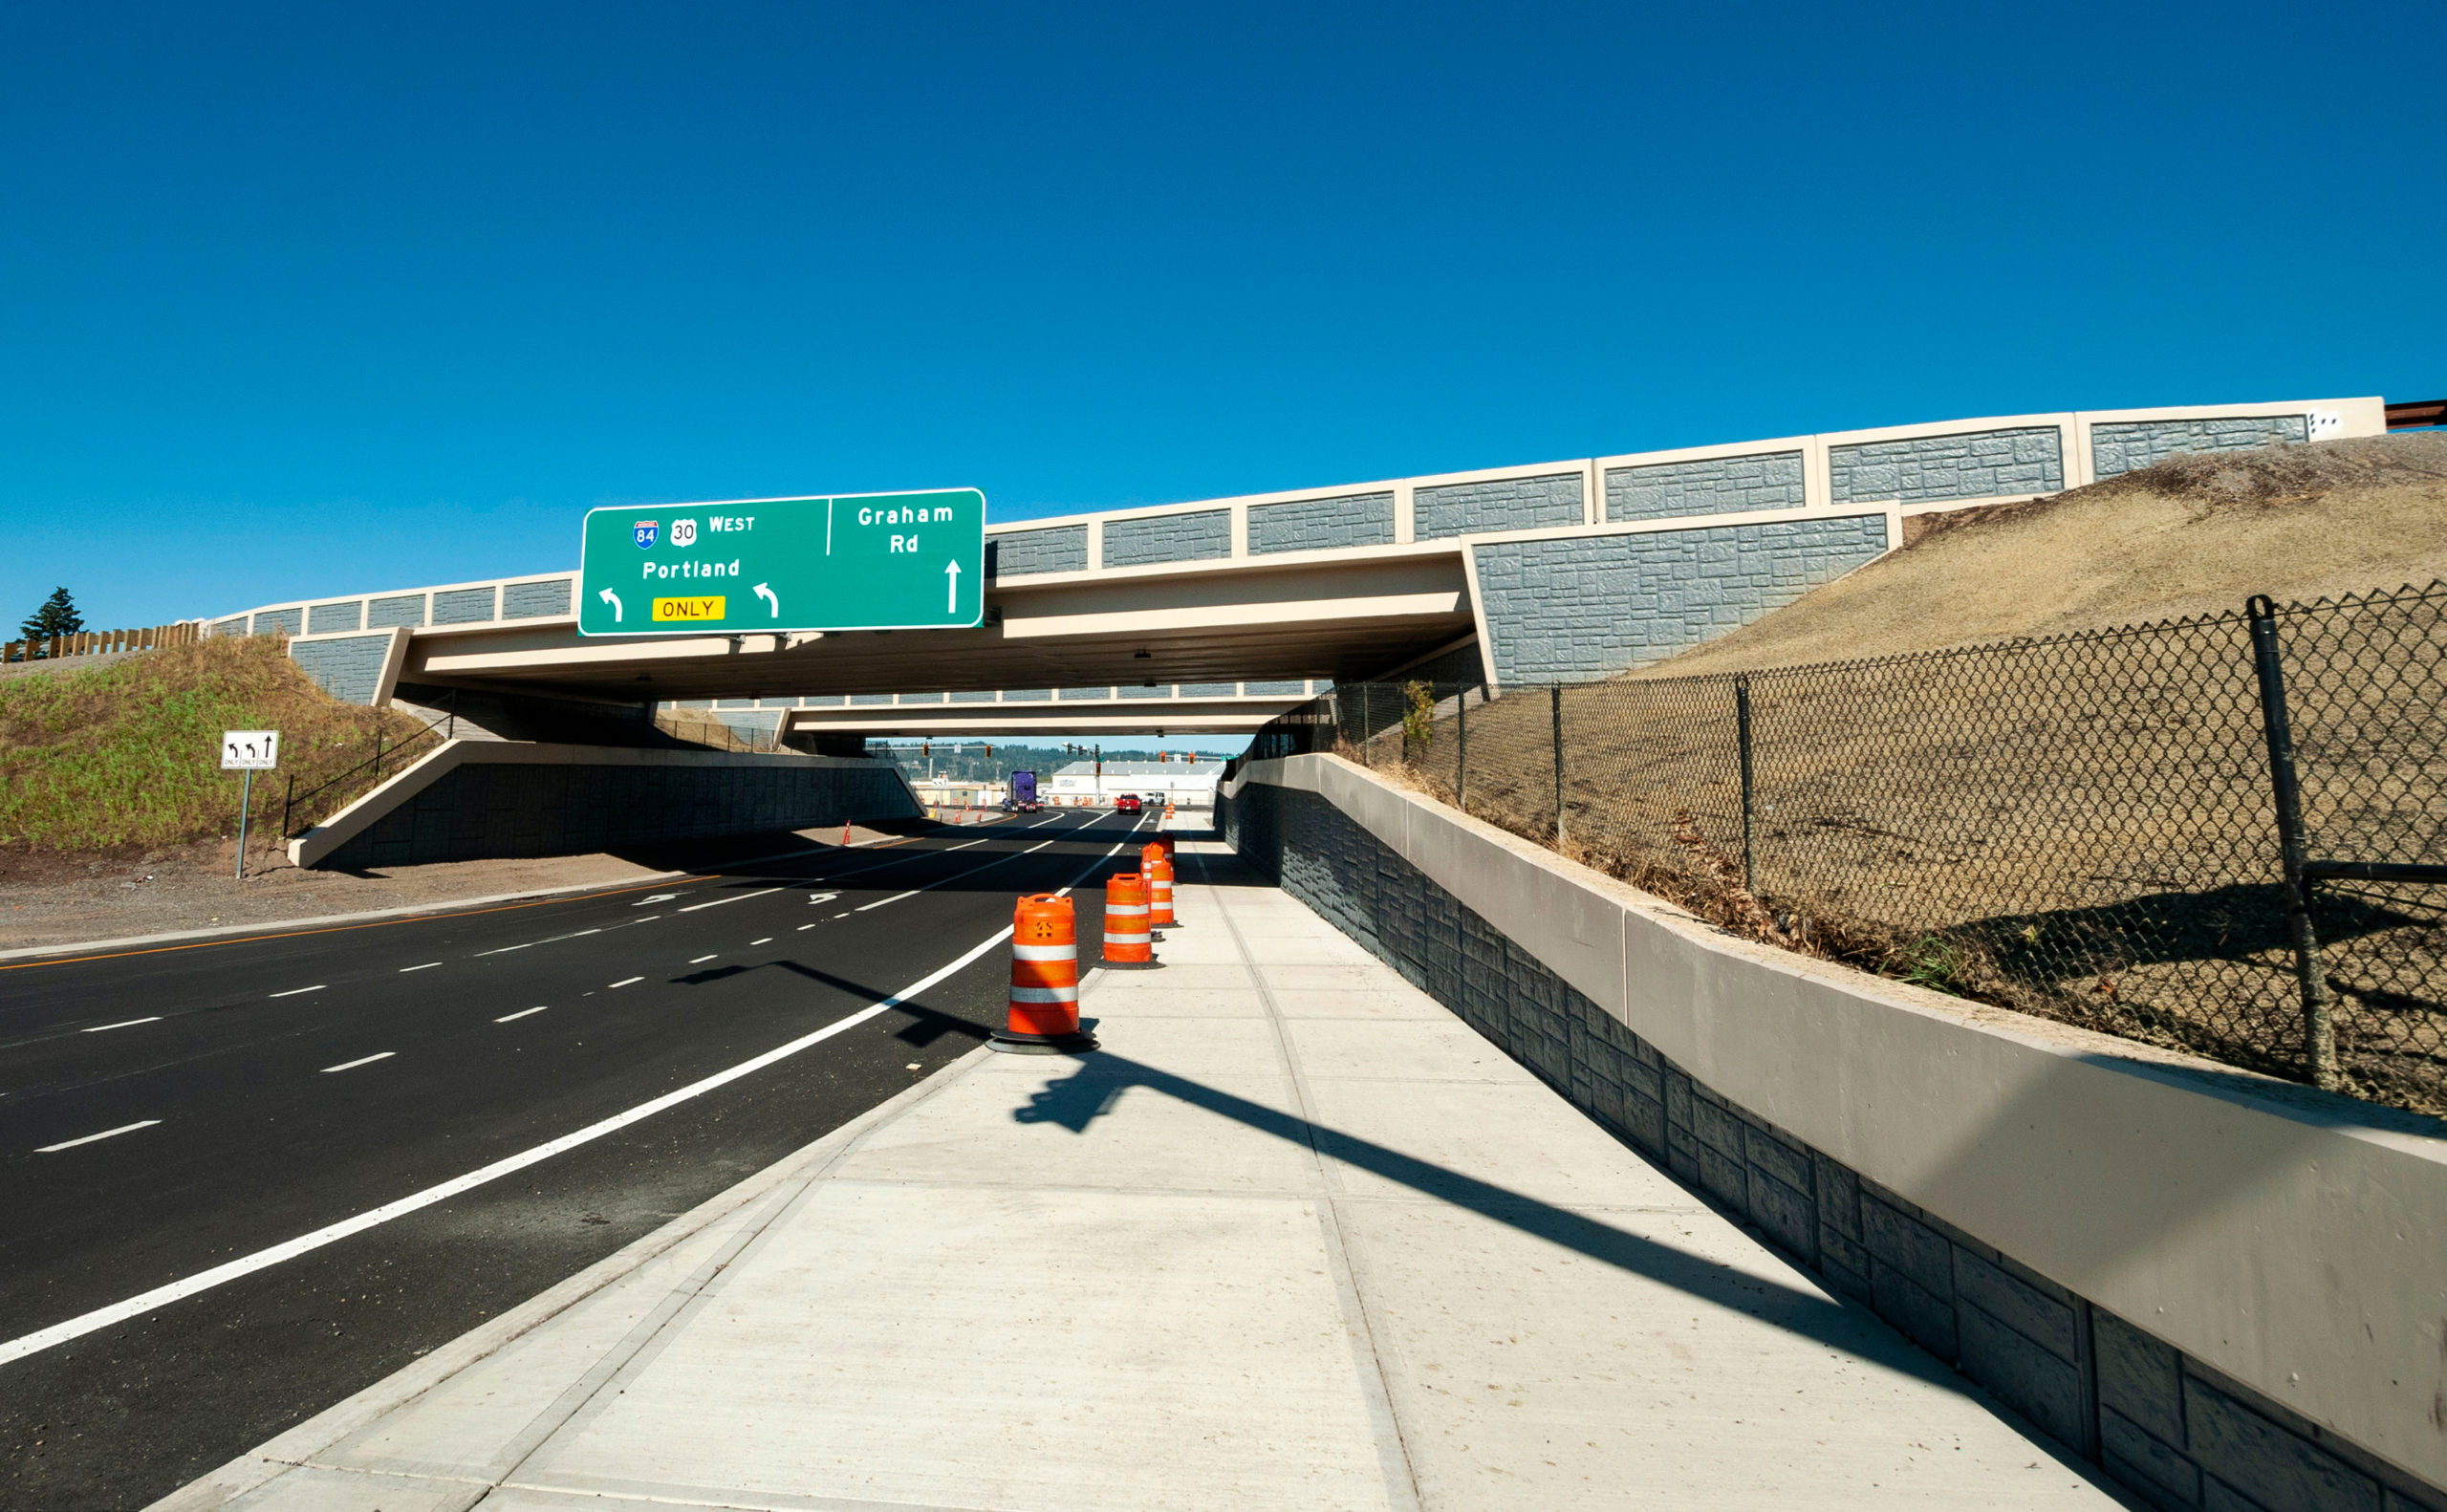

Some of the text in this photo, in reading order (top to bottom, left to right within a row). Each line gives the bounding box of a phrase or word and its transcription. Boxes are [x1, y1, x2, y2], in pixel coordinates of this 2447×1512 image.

[858, 506, 953, 526] Graham
[637, 516, 755, 543] 84 30 WEST
[890, 534, 919, 553] Rd
[642, 558, 740, 579] Portland
[662, 600, 714, 617] ONLY
